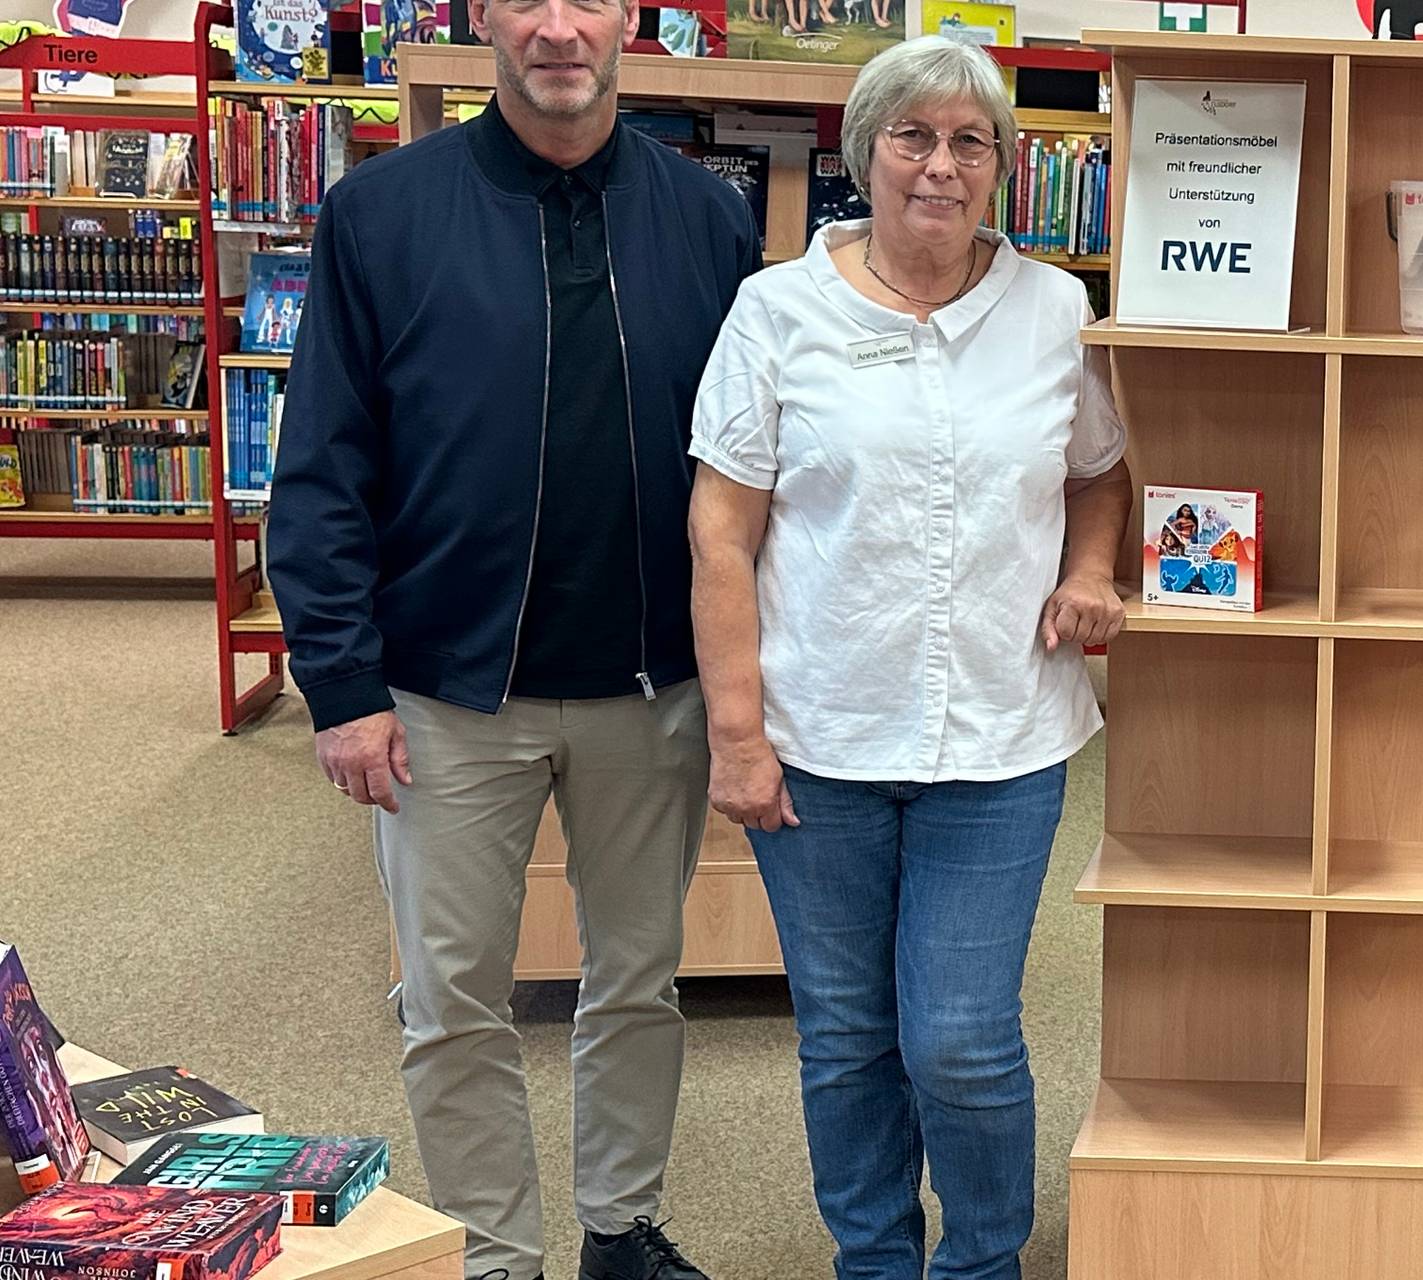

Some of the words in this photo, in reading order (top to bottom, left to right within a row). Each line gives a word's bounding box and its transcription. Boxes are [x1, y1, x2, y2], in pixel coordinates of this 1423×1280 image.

[265, 5, 318, 23] Kunst?
[44, 44, 98, 64] Tiere
[796, 38, 840, 53] Oetinger
[1155, 132, 1278, 148] Präsentationsmöbel
[702, 155, 744, 166] ORBIT
[703, 163, 748, 173] EPTUN
[1166, 161, 1186, 174] mit
[1188, 161, 1262, 175] freundlicher
[1169, 188, 1255, 205] Unterstützung
[1198, 218, 1221, 229] von
[1161, 240, 1252, 274] RWE
[858, 351, 878, 360] Anna
[1147, 593, 1159, 602] 5+
[96, 1086, 195, 1112] WILD
[180, 1096, 207, 1110] IN
[118, 1105, 173, 1124] THE
[141, 1106, 218, 1131] LOST
[147, 1133, 248, 1189] GIRLS
[199, 1134, 308, 1190] TRIP
[160, 1195, 255, 1248] WEAVER
[0, 1247, 65, 1267] WEAVE
[78, 1266, 137, 1279] JOHNSON
